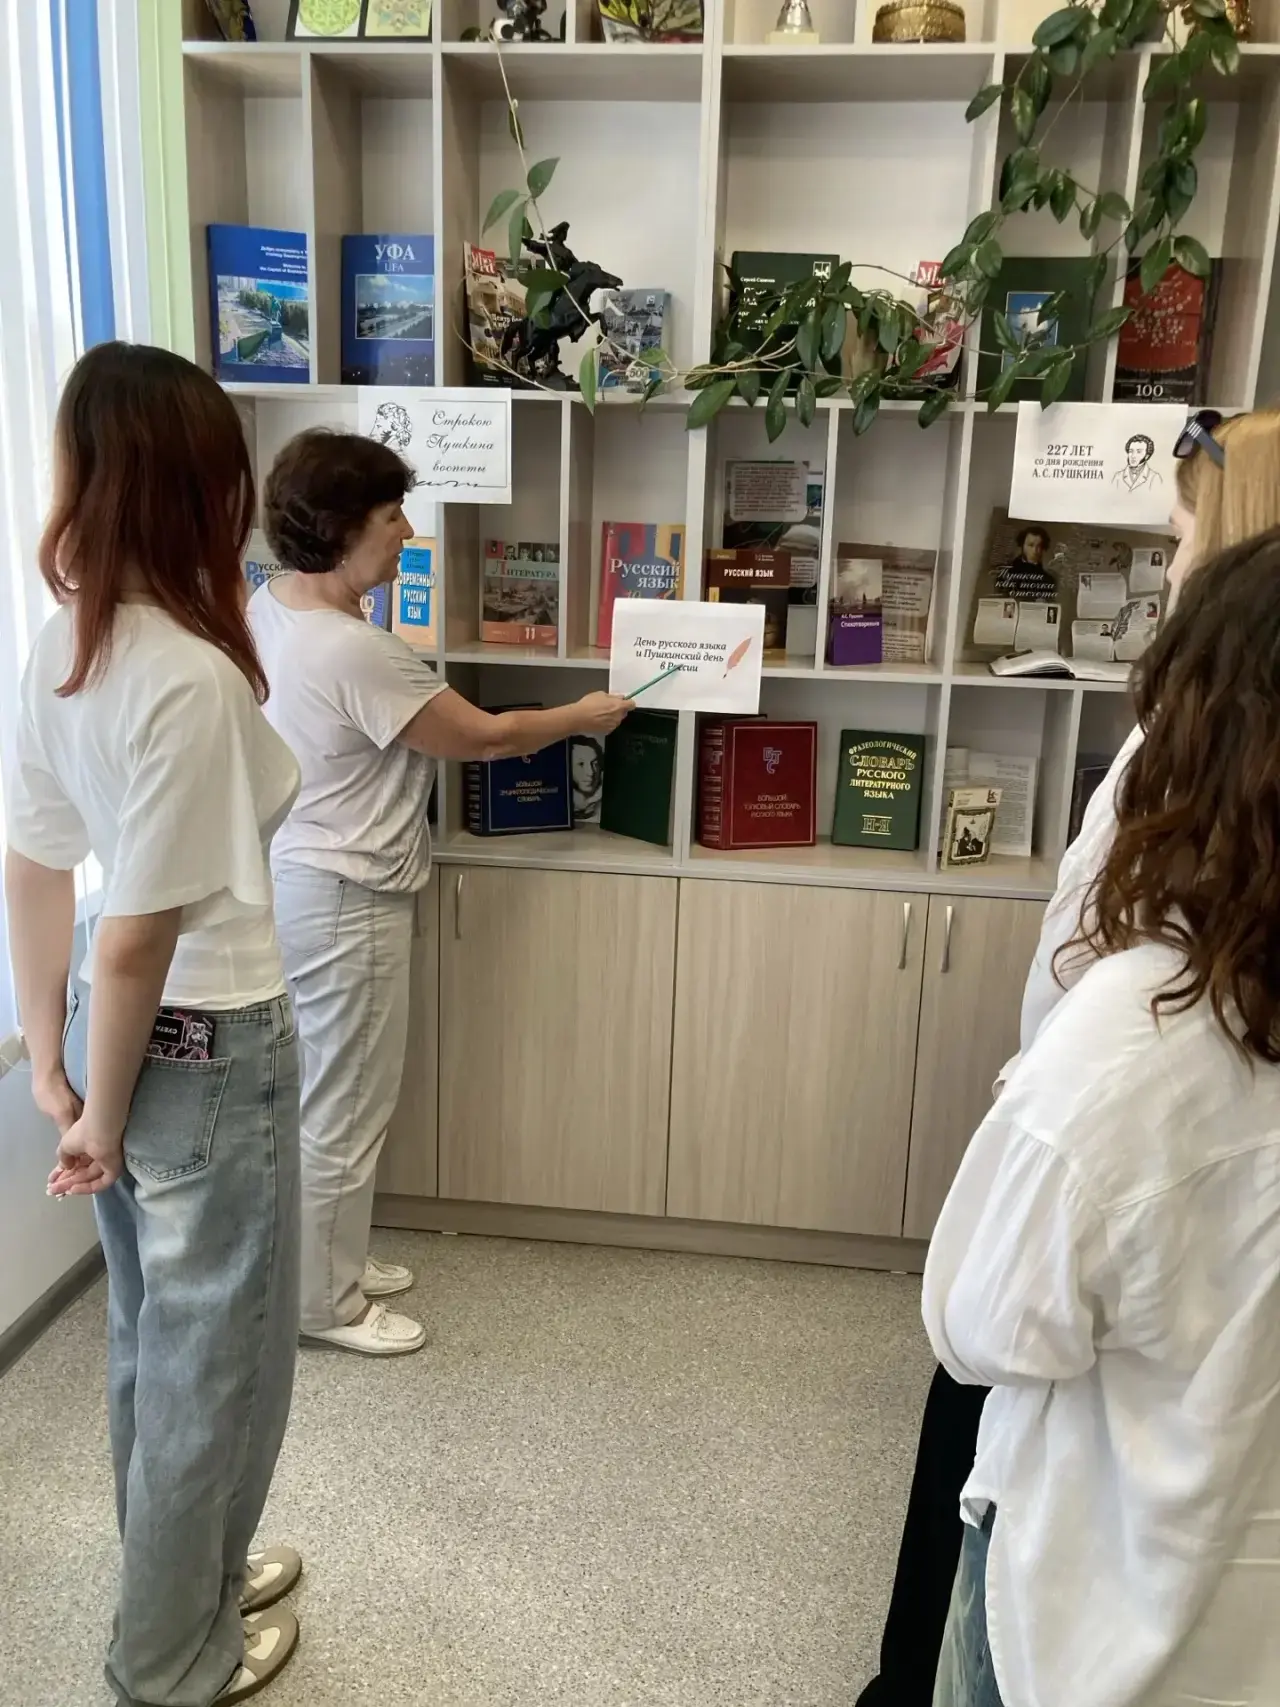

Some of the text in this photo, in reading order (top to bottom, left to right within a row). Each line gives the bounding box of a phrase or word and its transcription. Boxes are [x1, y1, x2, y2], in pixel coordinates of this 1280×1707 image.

[374, 243, 415, 260] УФА
[1135, 384, 1164, 397] 100
[432, 410, 492, 430] Строкою
[426, 433, 494, 454] Пушкина
[1047, 445, 1094, 456] 227 ЛЕТ
[432, 460, 486, 473] воспеты
[1062, 459, 1104, 467] рождения
[1053, 469, 1104, 480] ПУШКИНА
[610, 558, 681, 578] Русский
[724, 567, 774, 578] РУССКИЙ ЯЗЫК
[637, 576, 680, 590] язык
[404, 588, 427, 604] РУССКИЙ
[524, 627, 536, 641] 11
[633, 637, 727, 650] День русского языка
[643, 649, 702, 661] Пушкинский
[703, 653, 724, 663] день
[659, 661, 666, 670] в
[848, 740, 917, 760] ФРАЗЕОЛОГИЧЕСКИЙ
[849, 754, 915, 771] СЛОВАРЬ
[856, 768, 906, 780] РУССКОГО
[849, 778, 911, 791] ЛИТЕРАТУРНОГО
[863, 790, 894, 800] ЯЗЫКА
